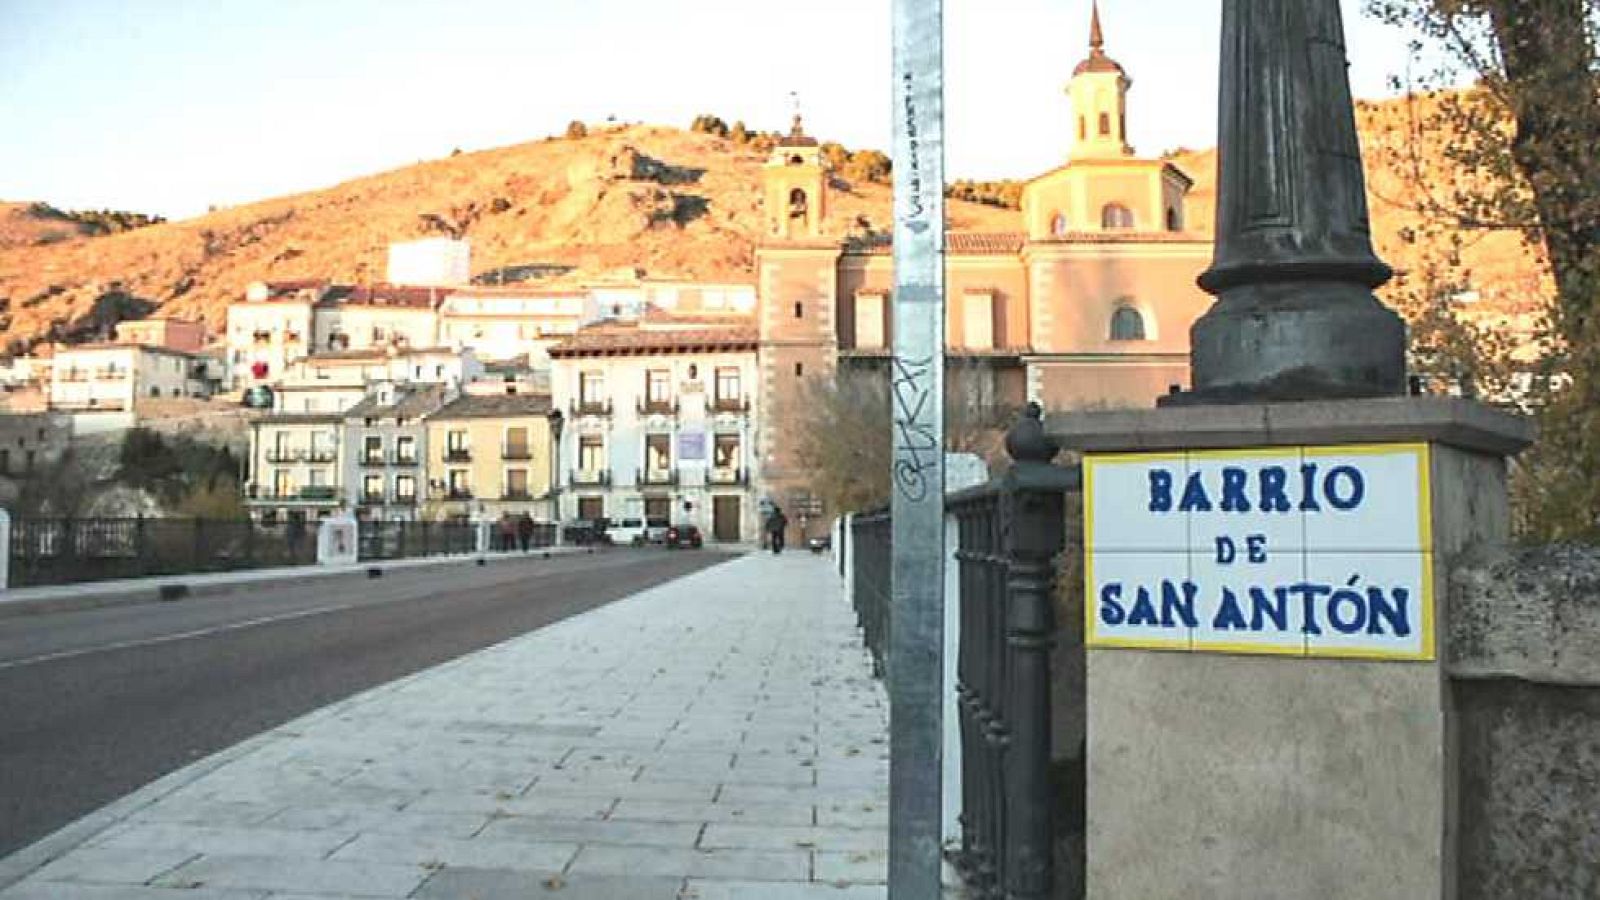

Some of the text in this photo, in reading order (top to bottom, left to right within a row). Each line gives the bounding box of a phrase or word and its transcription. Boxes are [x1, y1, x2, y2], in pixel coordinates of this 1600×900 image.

[1148, 463, 1365, 513] BARRIO
[1215, 534, 1267, 564] DE
[1100, 575, 1410, 637] SAN ANTÓN
